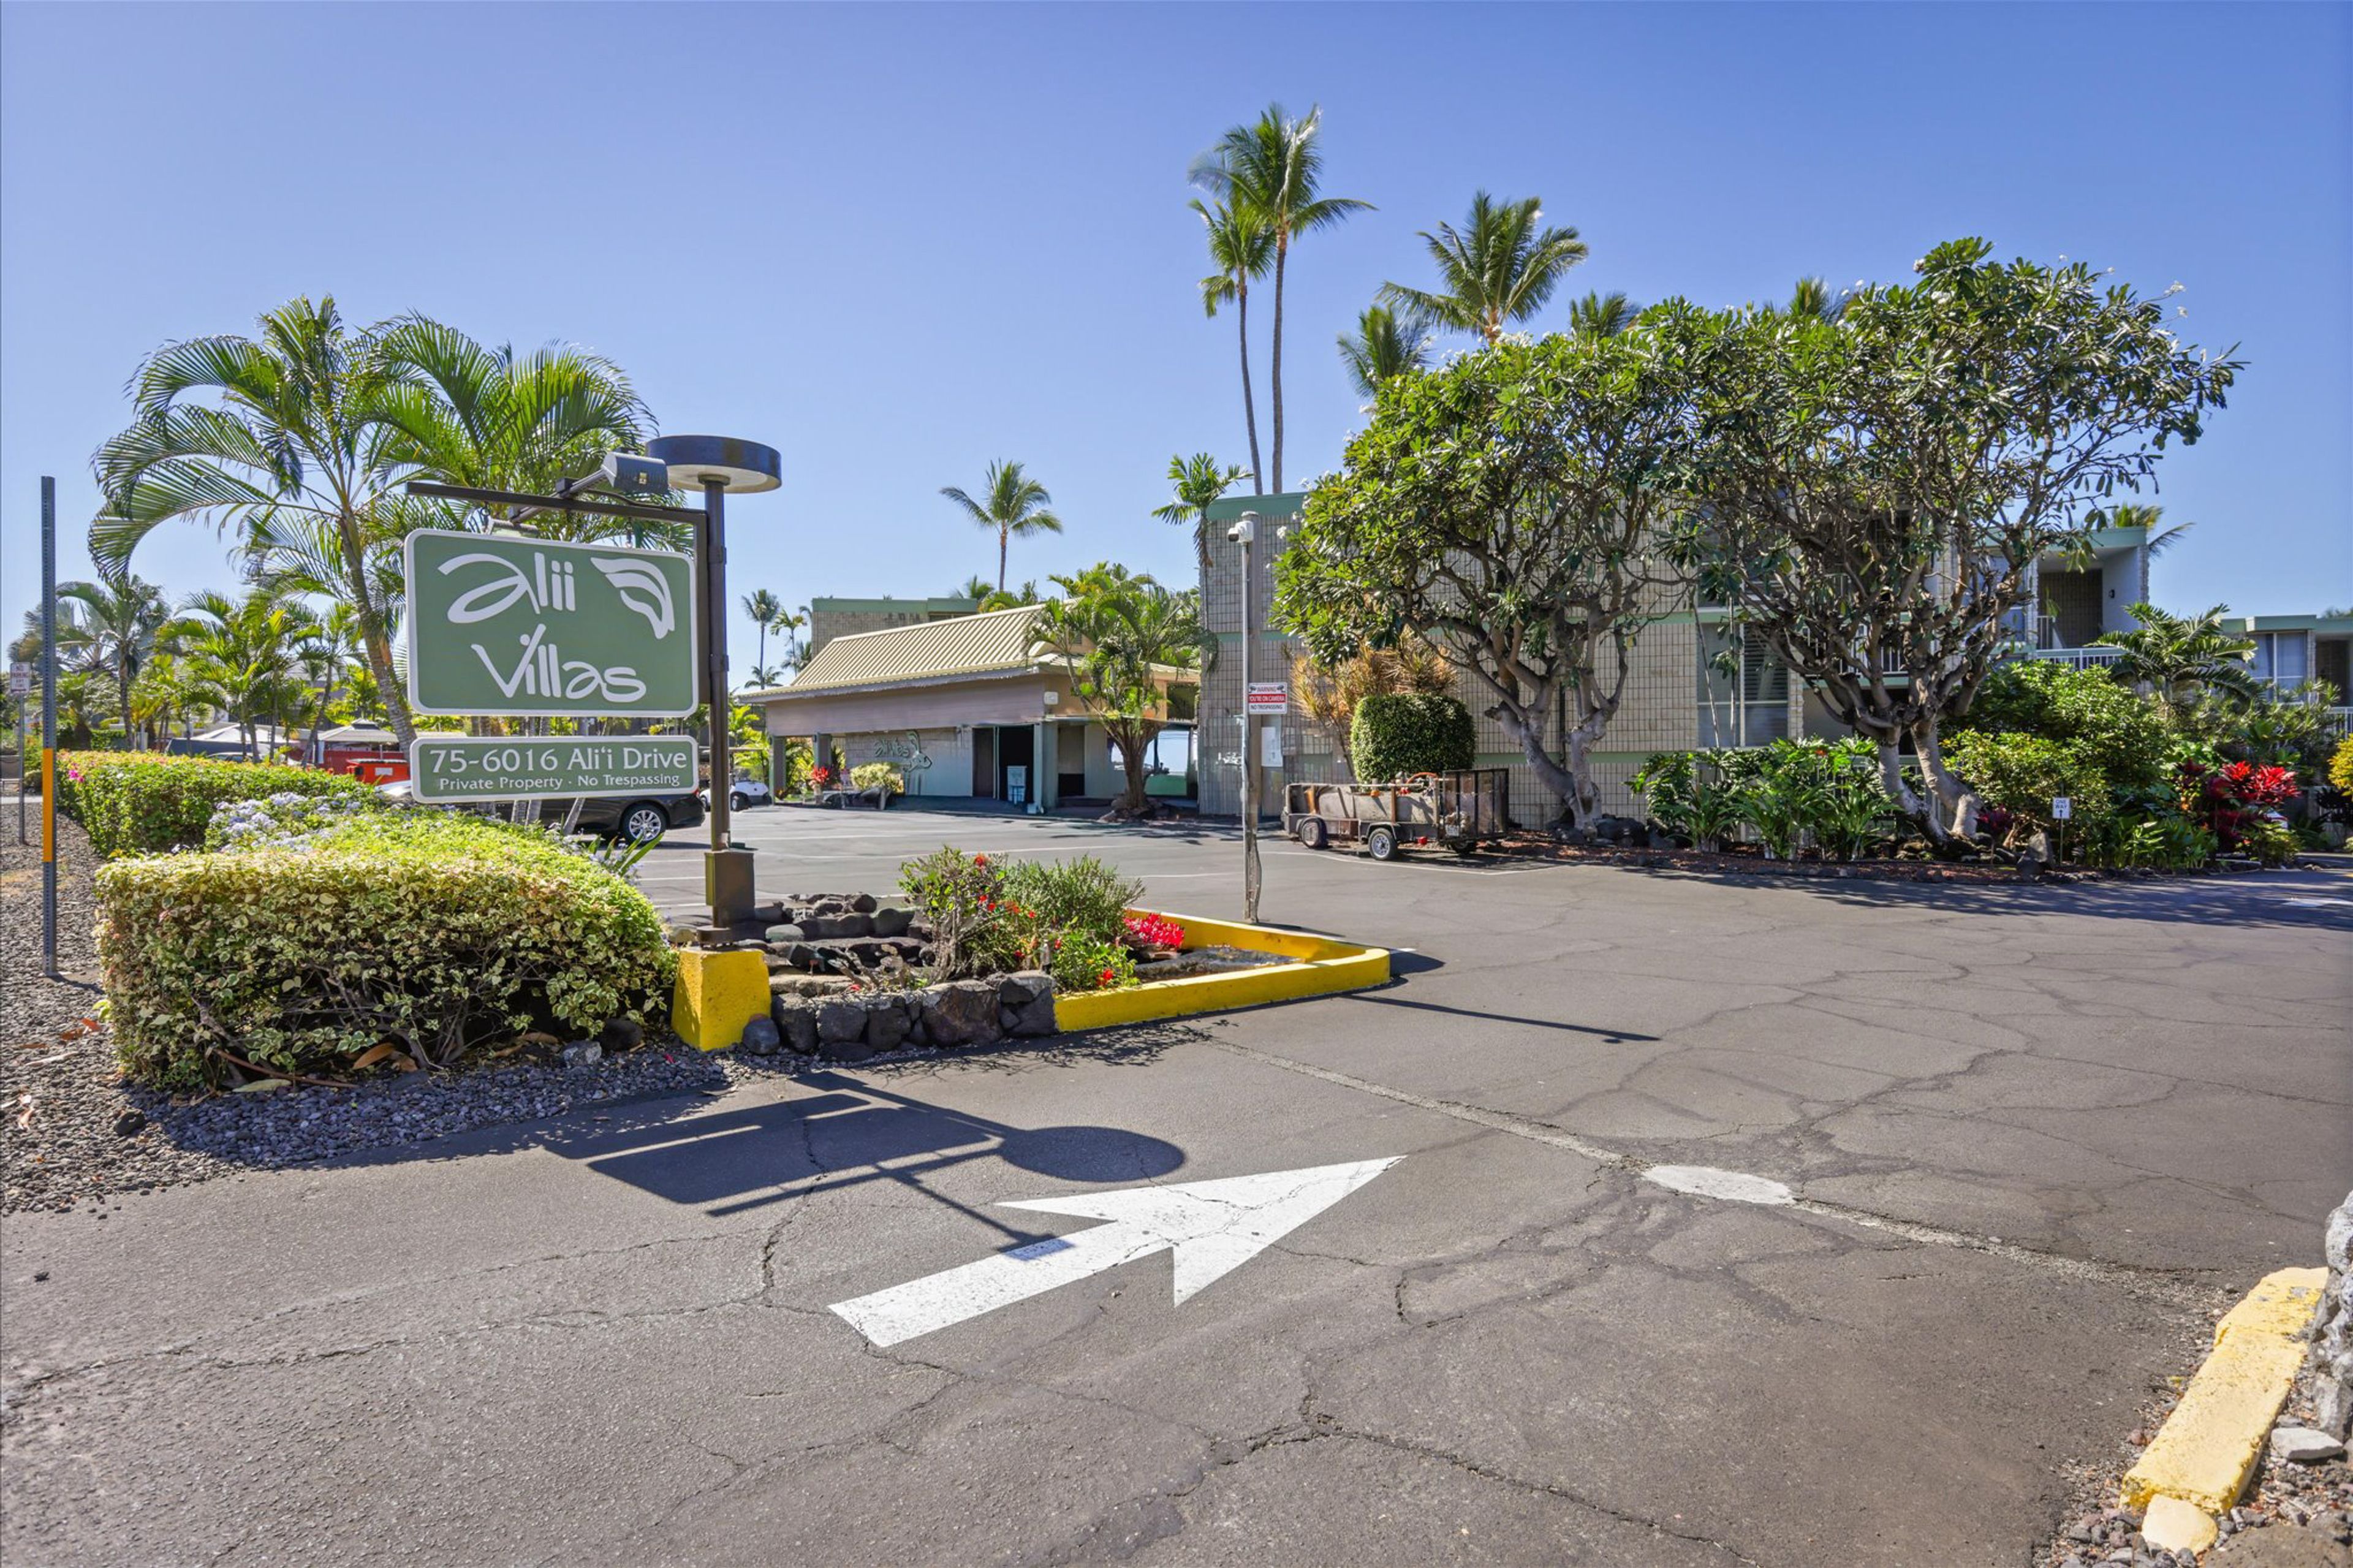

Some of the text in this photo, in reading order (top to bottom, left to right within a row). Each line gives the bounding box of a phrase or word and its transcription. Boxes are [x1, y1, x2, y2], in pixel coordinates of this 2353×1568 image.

[438, 552, 575, 623] Alii
[471, 623, 646, 703] Villas
[430, 749, 558, 773] 75-6016
[624, 746, 687, 770] Drive
[439, 773, 680, 790] Private Property No Trespassing
